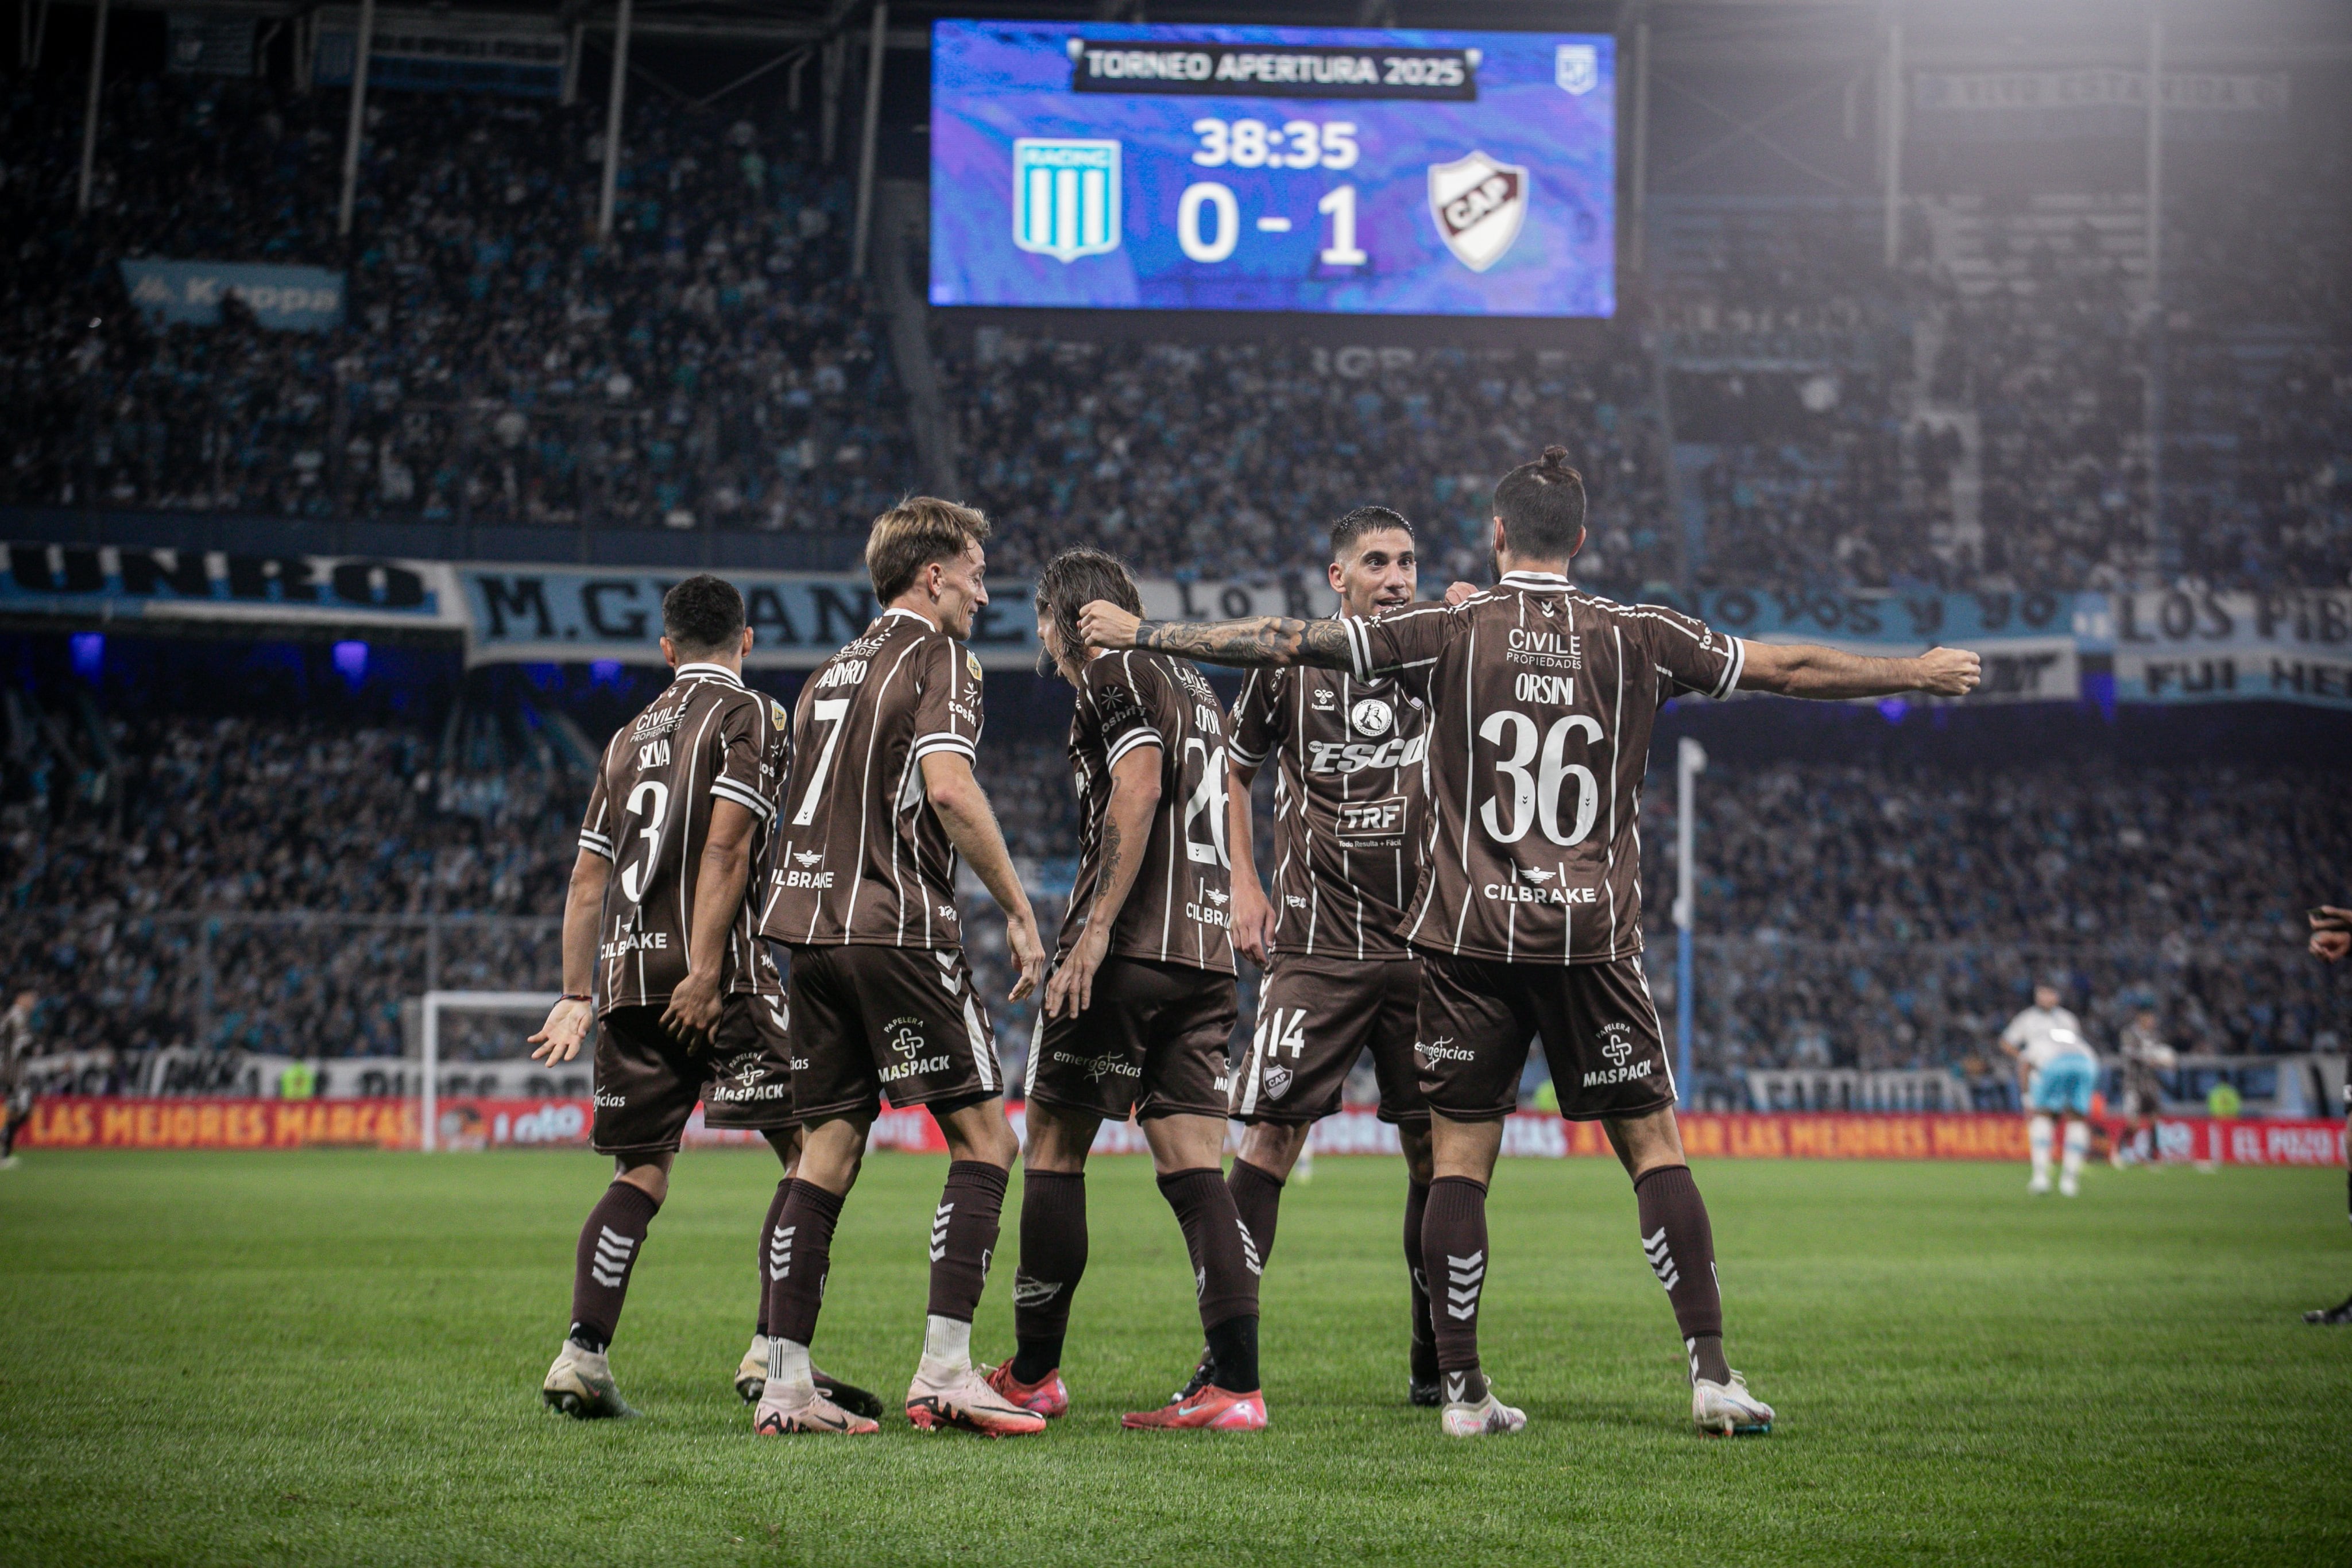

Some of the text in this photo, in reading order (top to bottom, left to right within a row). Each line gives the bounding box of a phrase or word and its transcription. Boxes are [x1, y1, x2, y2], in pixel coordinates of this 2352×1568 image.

[1087, 49, 1465, 87] TORNEO APERTURA 2025
[1192, 118, 1359, 169] 38:35
[1177, 181, 1240, 264] 0
[1317, 184, 1367, 266] 1
[1508, 628, 1581, 655] CIVILE
[1506, 651, 1582, 670] PROPIEDADES
[1515, 672, 1574, 706] ORSINI
[2271, 657, 2352, 697] HE
[1312, 703, 1335, 711] hummel
[637, 738, 671, 772] SILVA
[792, 699, 850, 826] 7
[1479, 710, 1604, 847] 36
[1184, 737, 1231, 872] 26
[1344, 804, 1400, 828] TRF
[621, 780, 669, 903] 3
[771, 868, 834, 889] ILBRAKE
[1483, 883, 1597, 904] CILBRAKE
[601, 932, 667, 961] CILBAKE
[883, 1016, 924, 1033] PAPELERA
[1267, 1007, 1307, 1059] 14
[1595, 1022, 1631, 1039] PAPELERA
[877, 1055, 950, 1083] MASPACK
[1268, 1073, 1287, 1088] CAP
[1583, 1059, 1652, 1088] MASPACK
[31, 1104, 94, 1145] LAS
[102, 1104, 267, 1146] MEJORES
